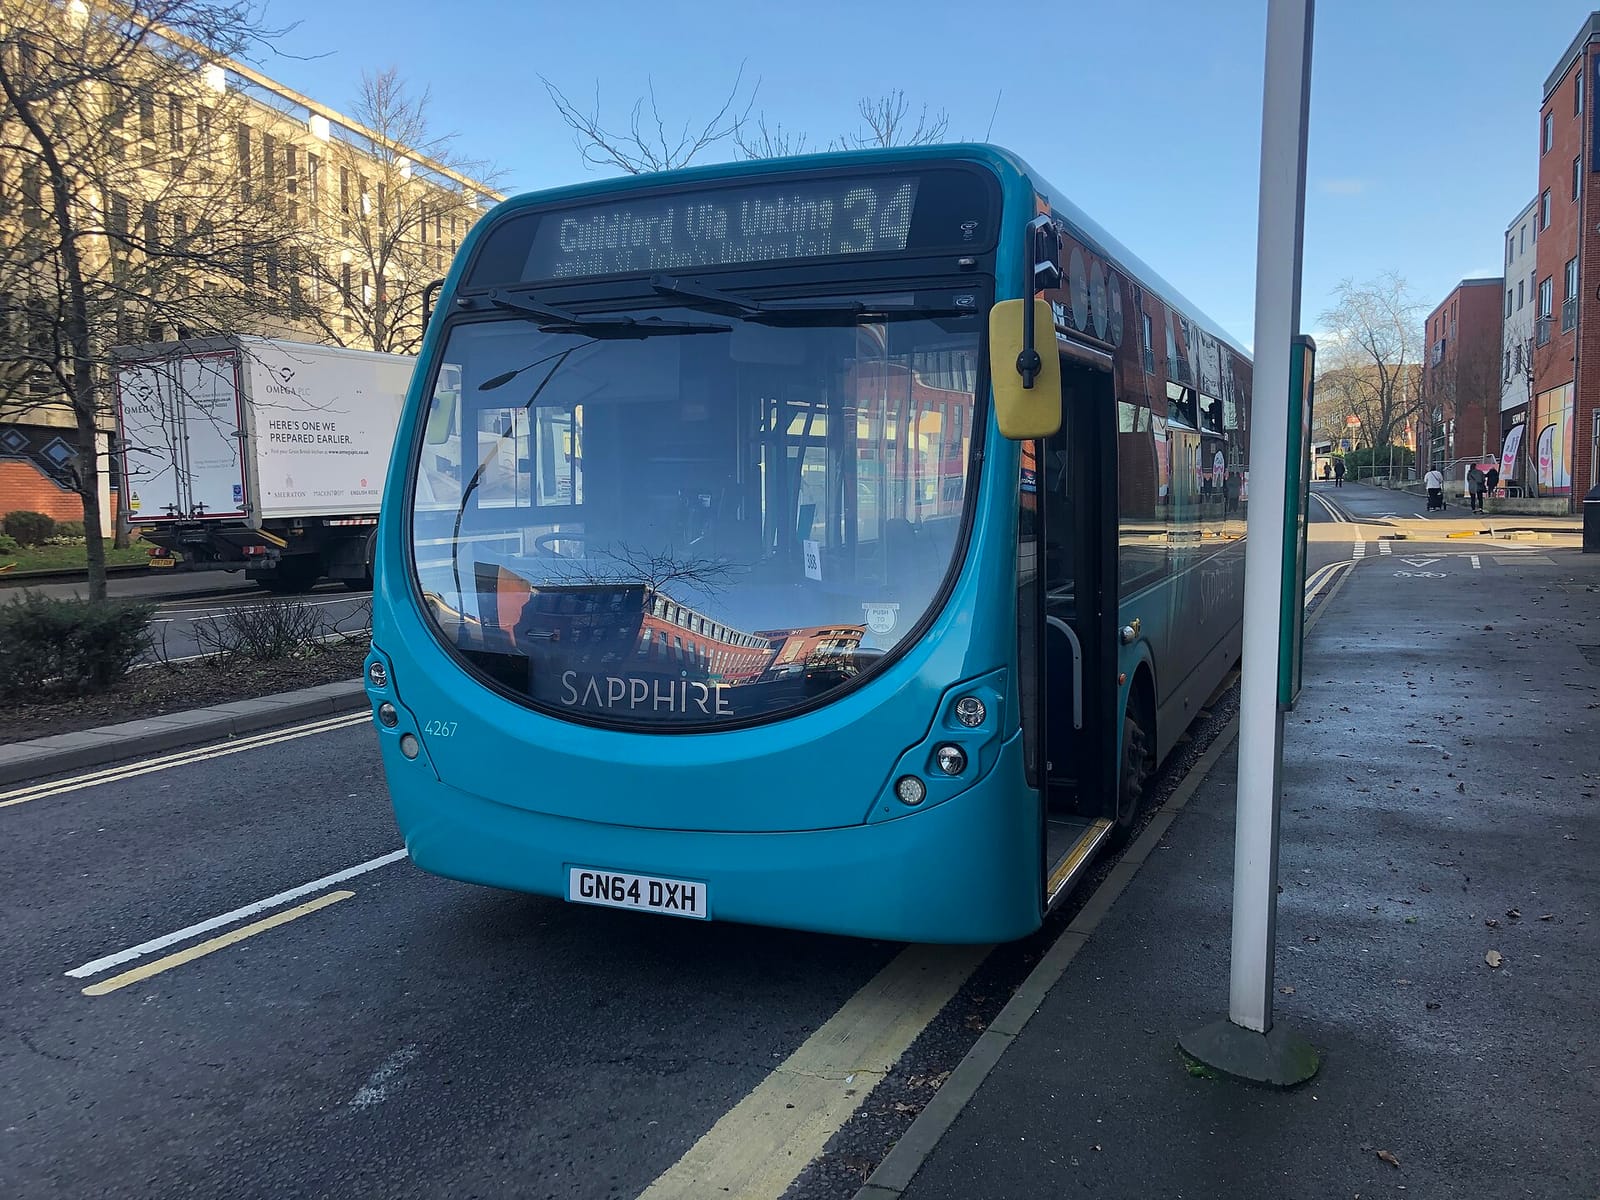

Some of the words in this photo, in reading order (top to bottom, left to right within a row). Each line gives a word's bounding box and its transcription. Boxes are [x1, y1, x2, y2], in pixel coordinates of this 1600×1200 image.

[559, 208, 673, 252] Guildford
[686, 204, 728, 240] Via
[740, 195, 833, 236] Woking
[840, 184, 911, 253] 34
[265, 384, 296, 395] OMEGA
[269, 420, 300, 430] HERE'S
[301, 421, 320, 431] ONE
[322, 422, 336, 431] WE
[270, 433, 315, 443] PREPARED
[317, 434, 352, 444] EARLIER.
[424, 719, 458, 737] 4267
[579, 872, 641, 904] GN64
[648, 880, 696, 912] DXH
